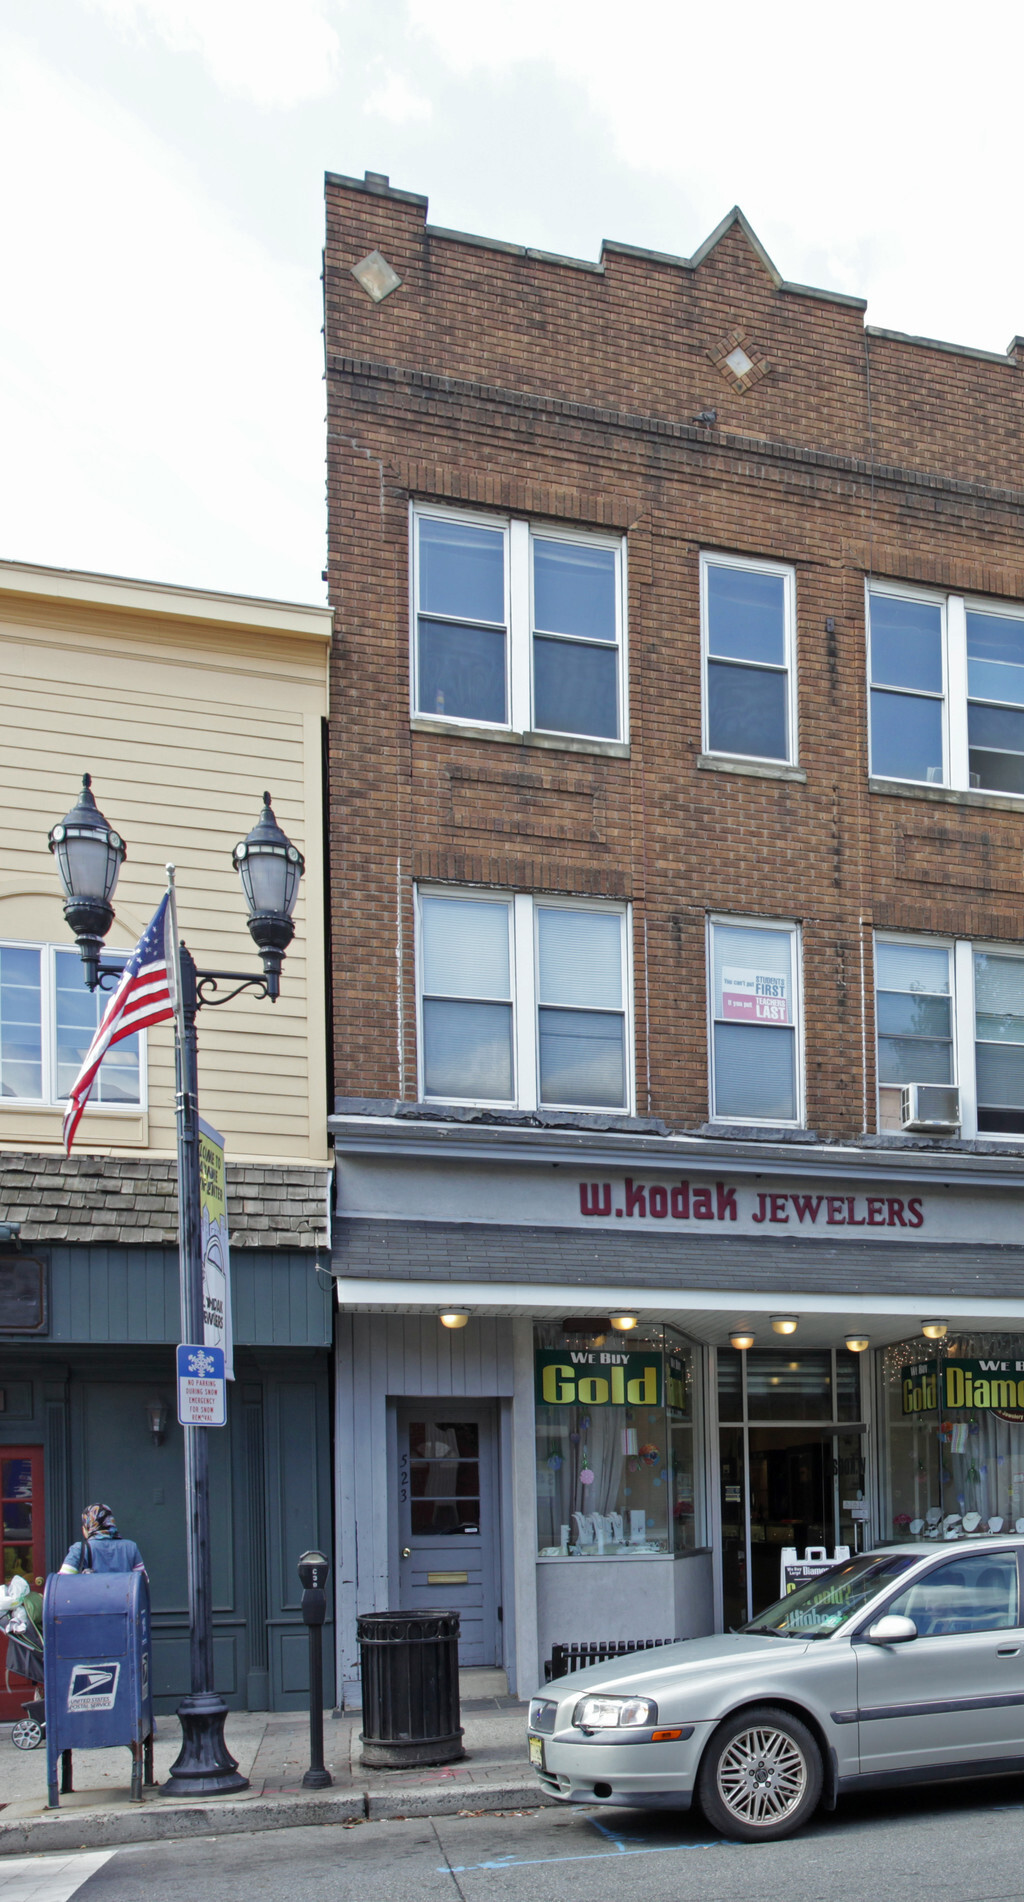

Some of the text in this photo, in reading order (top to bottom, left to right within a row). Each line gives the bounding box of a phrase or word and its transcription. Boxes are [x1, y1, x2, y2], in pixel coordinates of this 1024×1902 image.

[755, 975, 785, 986] STUDENTS
[755, 983, 785, 998] FIRST
[755, 997, 786, 1008] TEACHERS
[755, 1004, 786, 1020] LAST
[752, 1192, 924, 1228] JEWELERS
[186, 1387, 204, 1395] DURING
[542, 1364, 658, 1405] Gold
[188, 1396, 216, 1404] EMERGENCY
[902, 1373, 937, 1414] Gold
[399, 1454, 409, 1503] 523
